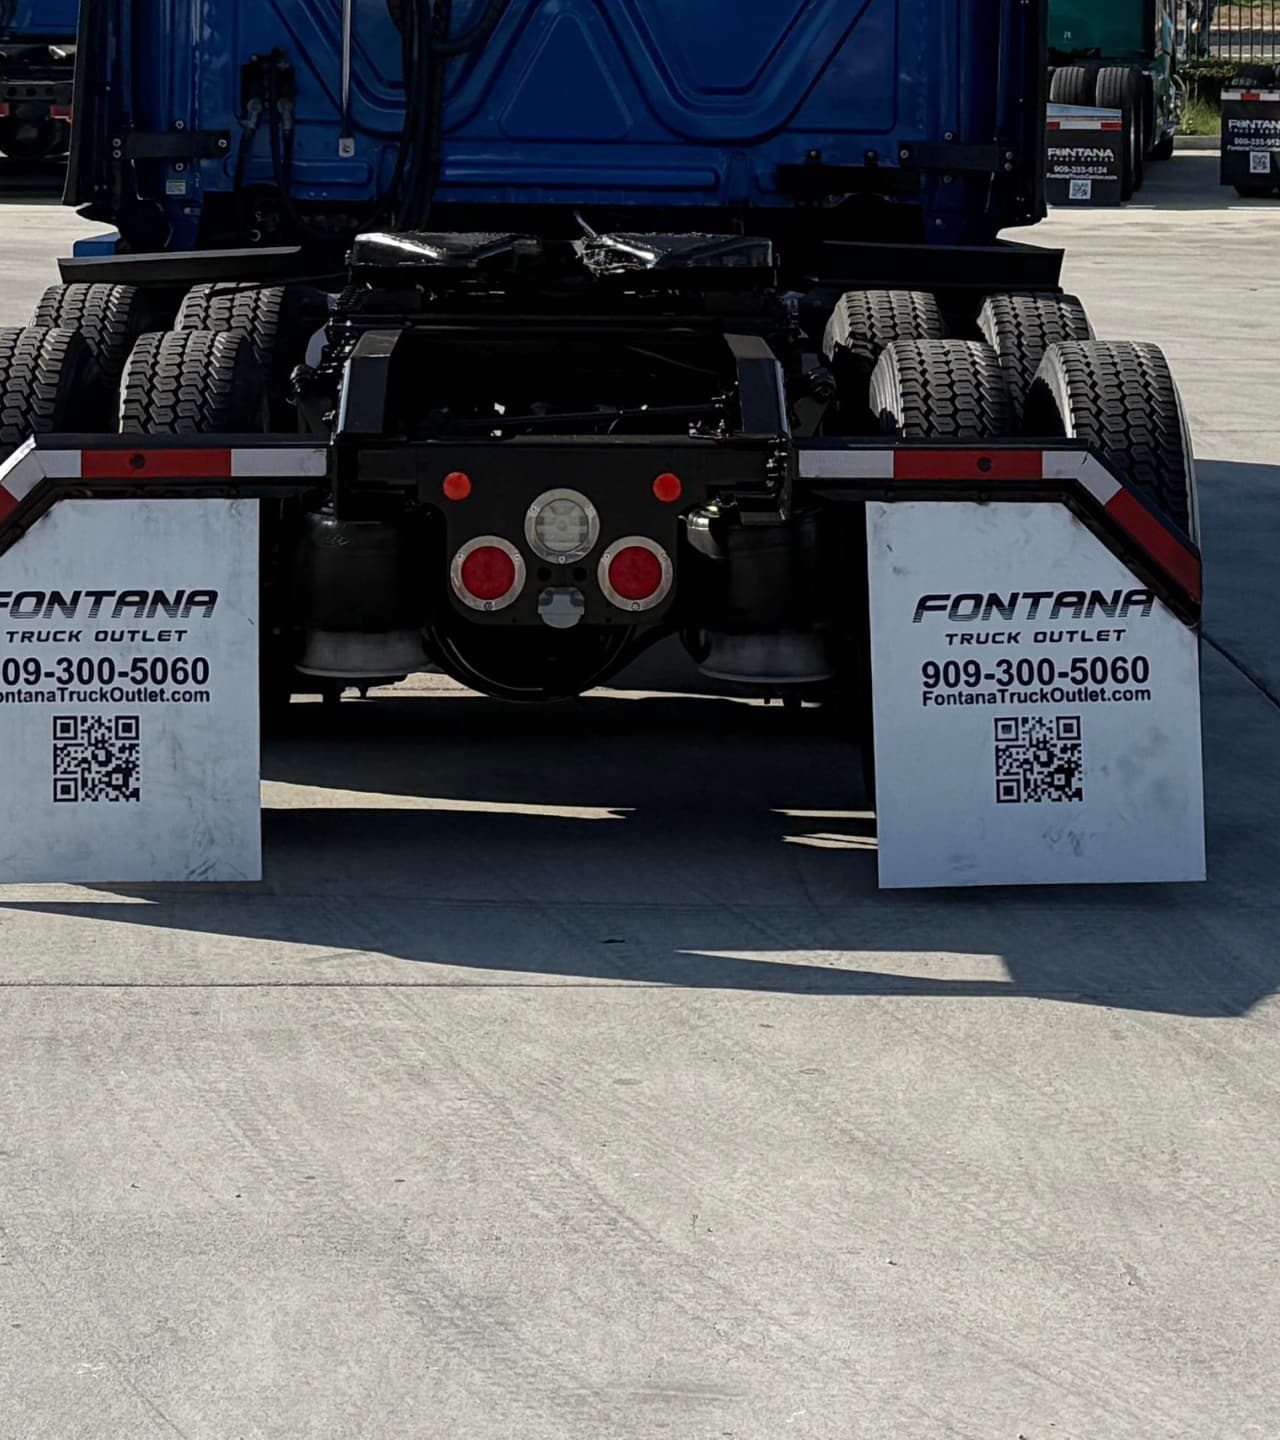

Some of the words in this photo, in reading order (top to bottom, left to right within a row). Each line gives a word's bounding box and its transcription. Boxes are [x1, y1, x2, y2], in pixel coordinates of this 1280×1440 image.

[1047, 148, 1114, 158] FONTANA
[912, 589, 1156, 623] FONTANA
[6, 630, 83, 643] TRUCK
[94, 630, 188, 643] OUTLET
[945, 631, 1021, 646] TRUCK
[1033, 629, 1126, 643] OUTLET
[921, 656, 1150, 689] 909-300-5060
[922, 687, 1151, 707] FontanaTruckOutlet.com
